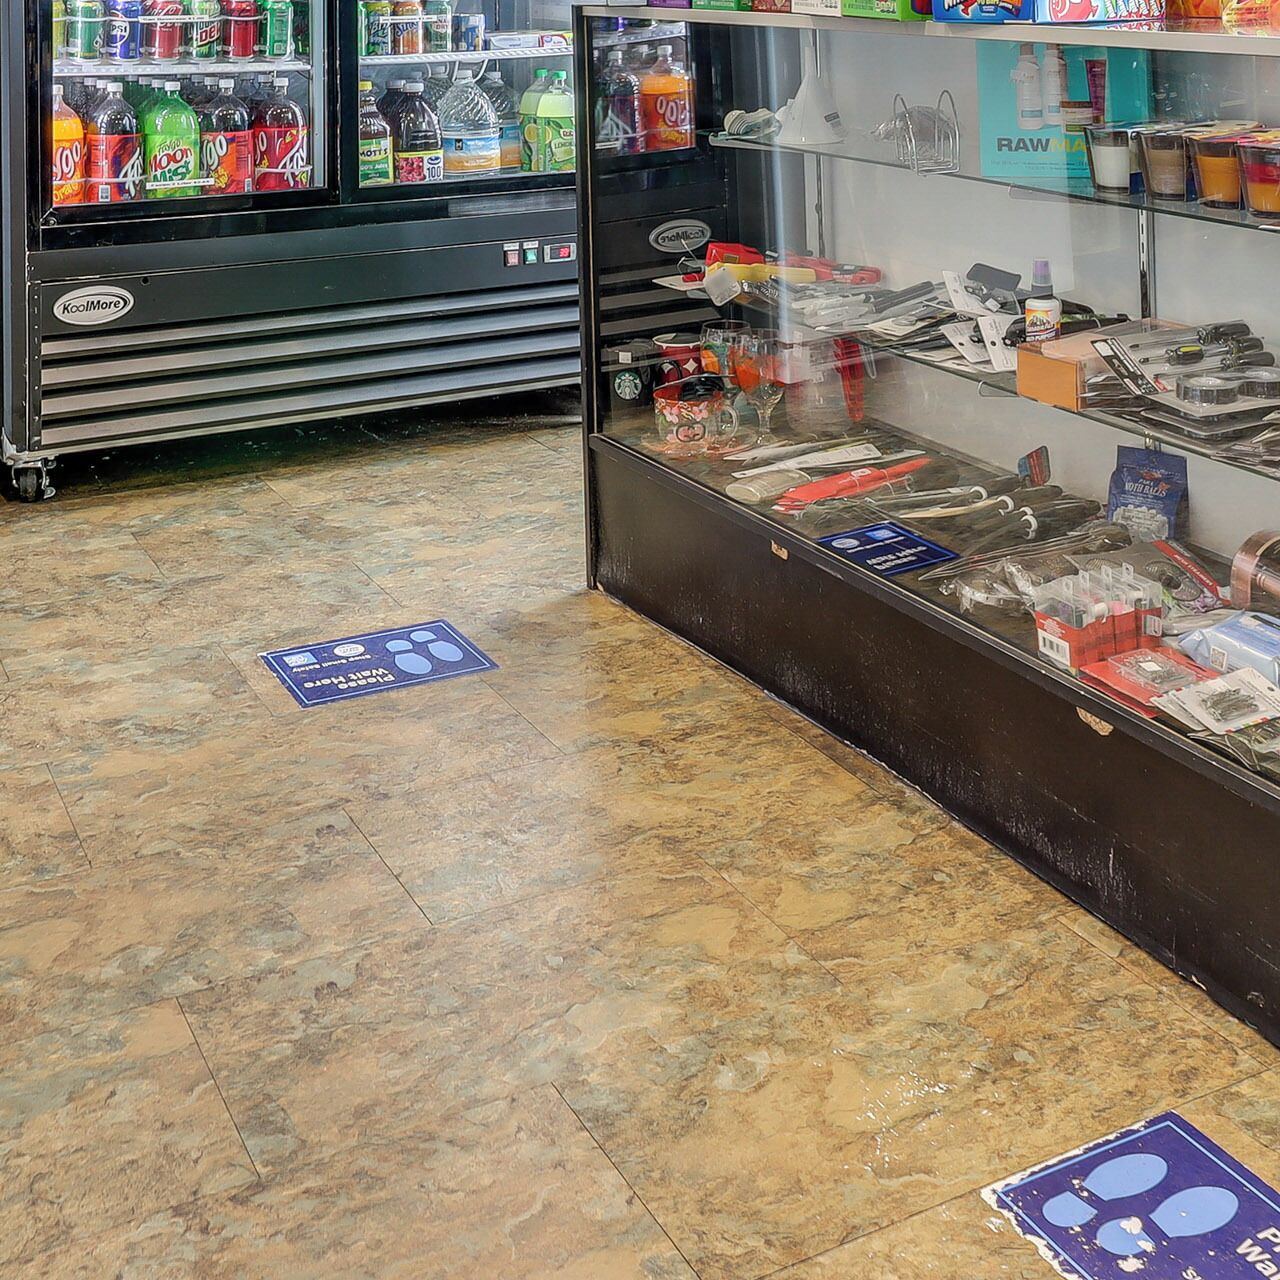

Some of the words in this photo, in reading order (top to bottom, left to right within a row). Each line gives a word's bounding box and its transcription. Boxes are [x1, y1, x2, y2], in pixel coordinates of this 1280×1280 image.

[61, 297, 122, 315] KoolMore
[303, 675, 343, 689] Here
[337, 672, 396, 691] Please
[346, 666, 389, 682] Wait
